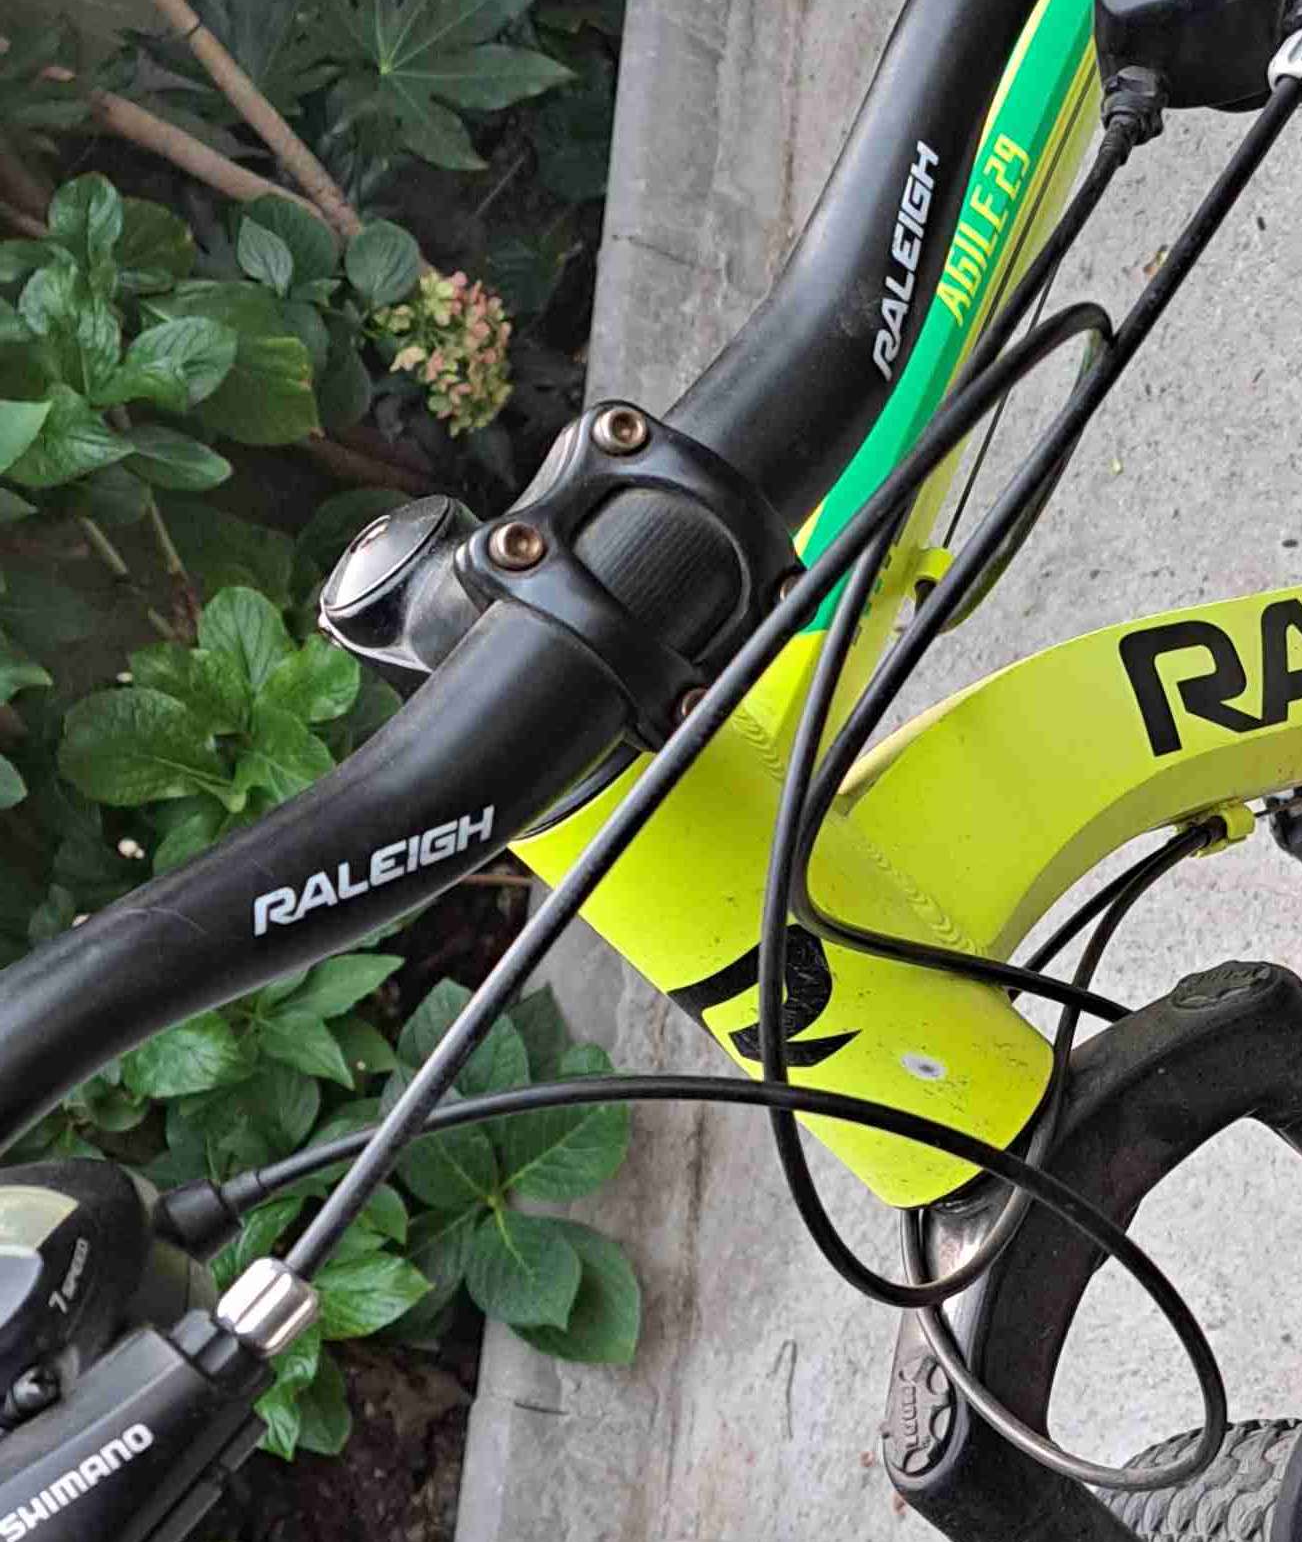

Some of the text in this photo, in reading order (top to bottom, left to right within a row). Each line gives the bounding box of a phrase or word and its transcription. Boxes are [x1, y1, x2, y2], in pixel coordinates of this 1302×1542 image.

[983, 132, 1030, 202] 29
[873, 140, 939, 382] RALEIGH
[254, 805, 495, 936] RALEIGH
